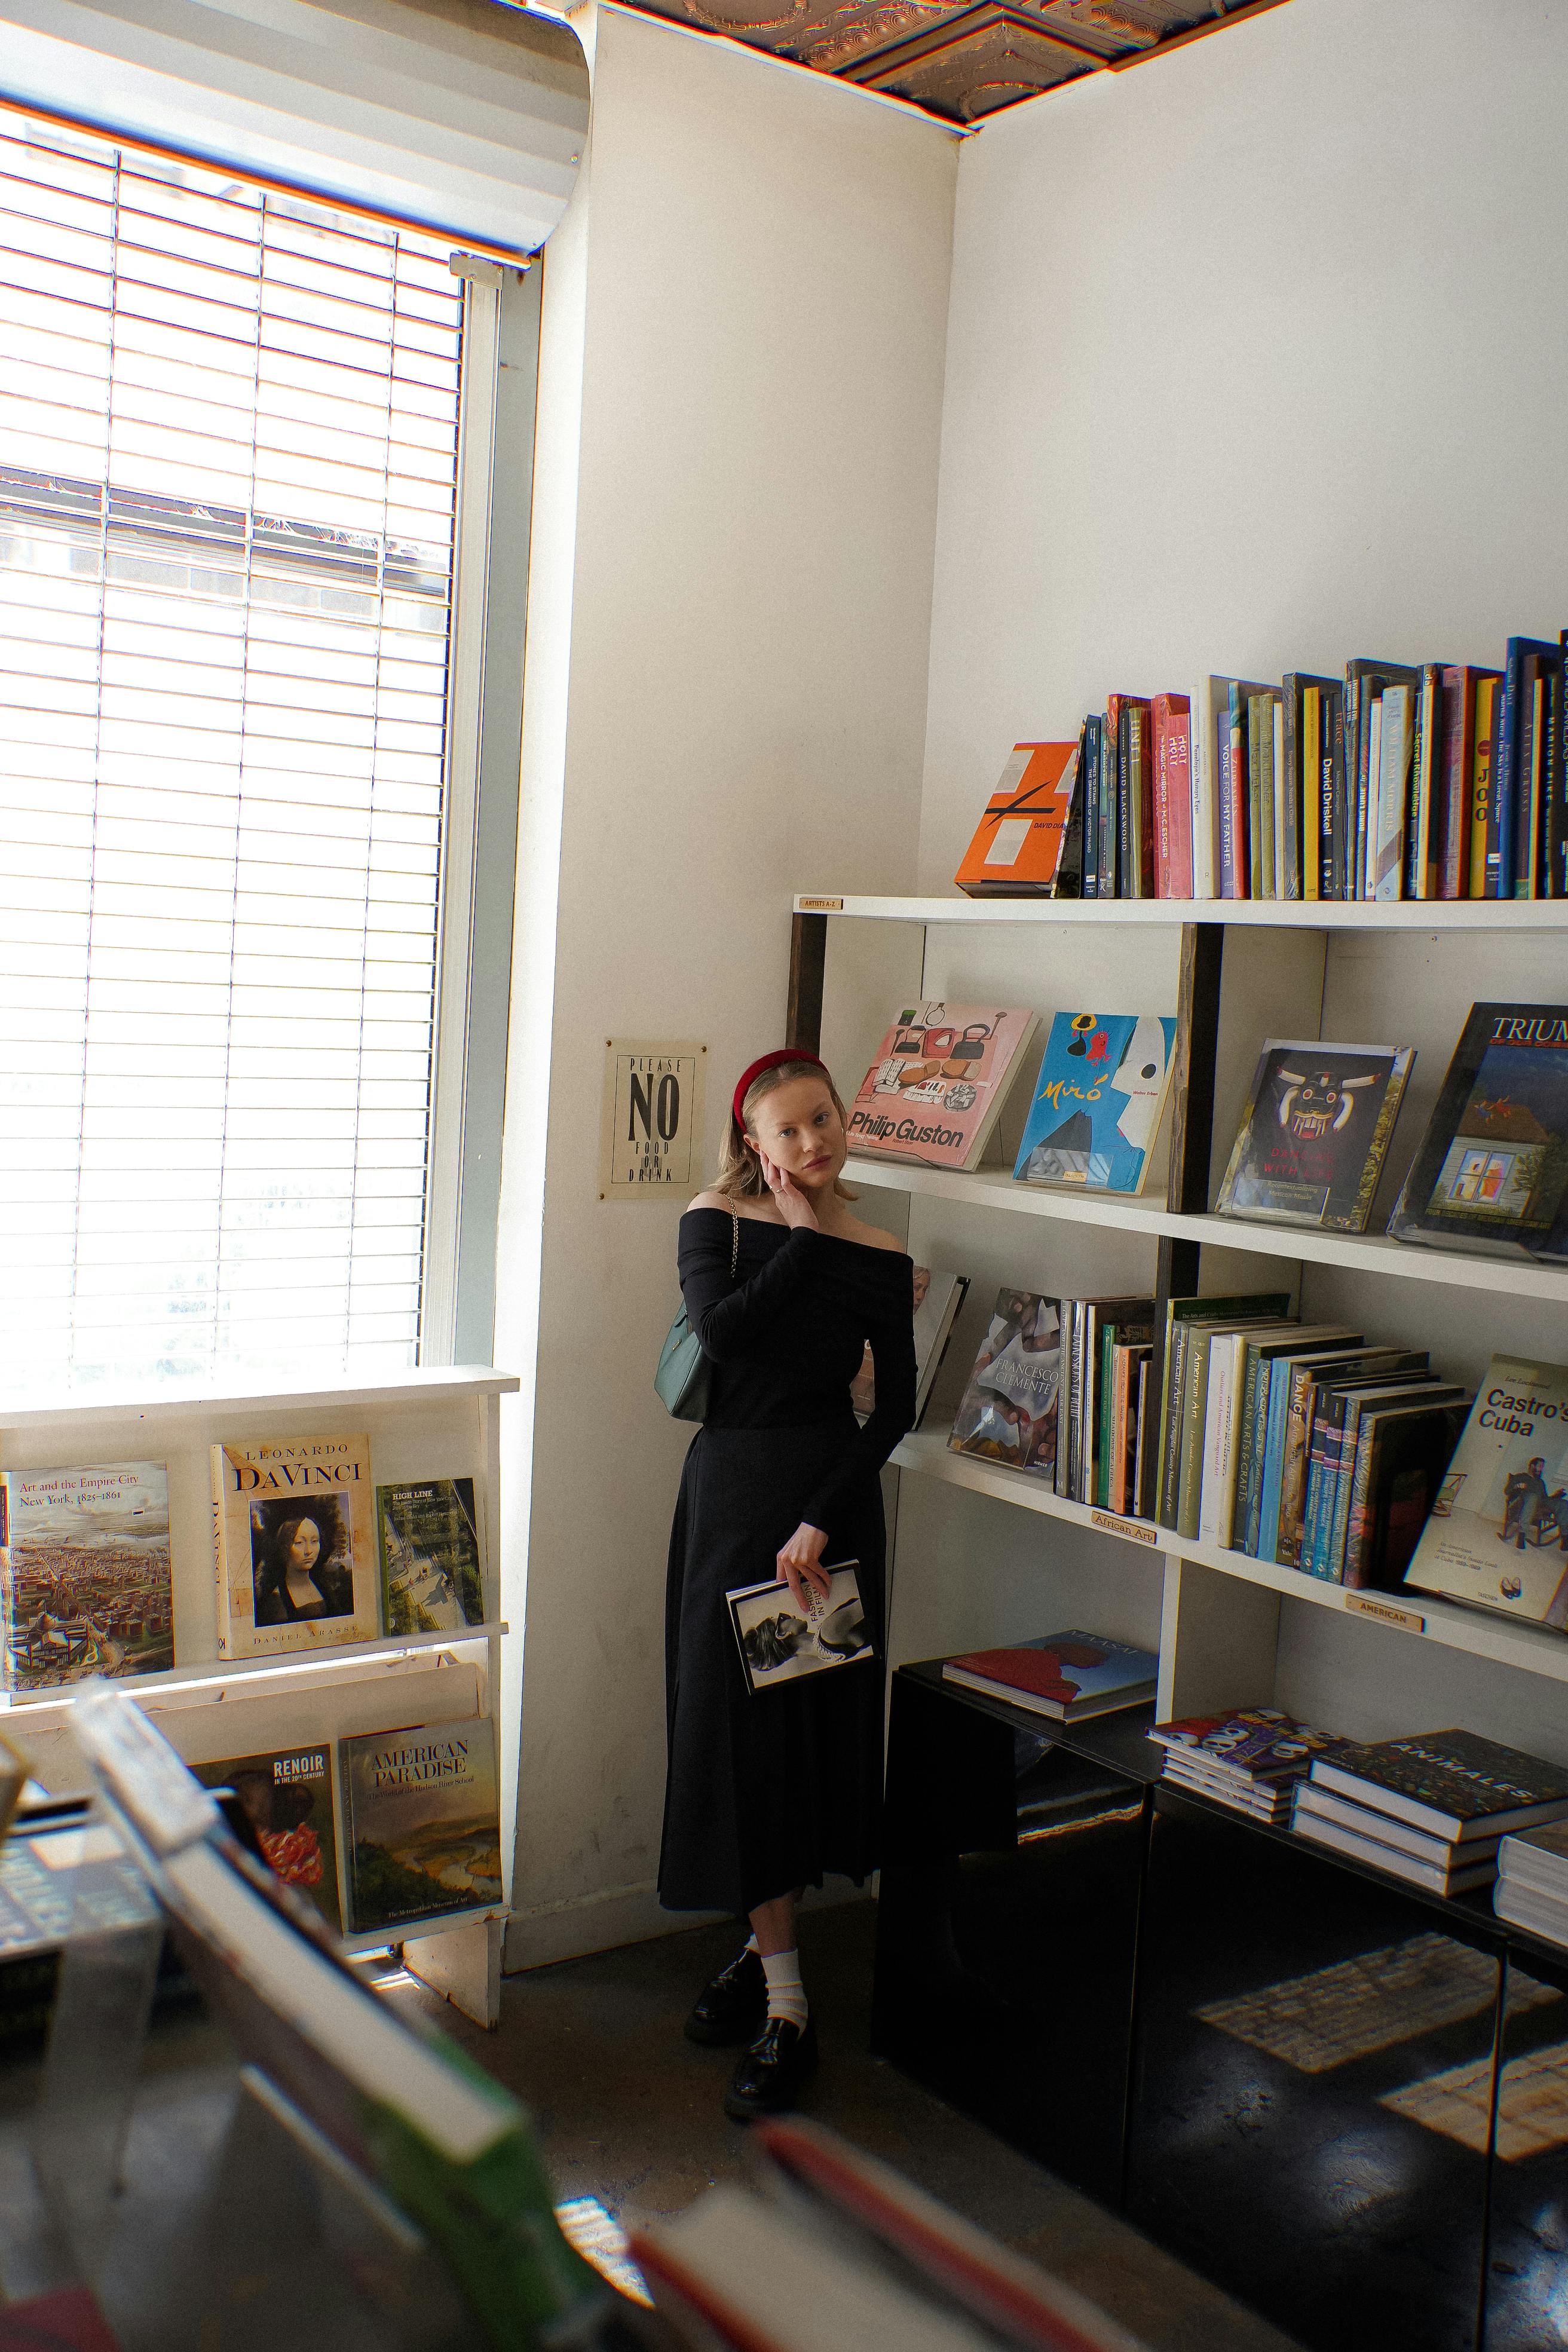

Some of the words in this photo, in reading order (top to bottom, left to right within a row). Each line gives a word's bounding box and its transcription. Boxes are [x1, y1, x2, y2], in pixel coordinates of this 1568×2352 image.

[1169, 736, 1178, 766] HOLY
[1178, 734, 1187, 764] HOLY
[1387, 725, 1398, 779] WILLIAM
[1413, 733, 1422, 764] Secret
[1322, 758, 1333, 792] David
[1411, 765, 1420, 816] Knowledge
[1521, 767, 1530, 813] GROSS
[1223, 803, 1231, 820] MY
[1322, 792, 1333, 835] Driskell
[1386, 783, 1395, 831] MORRIS
[630, 1058, 681, 1072] PLEASE
[1037, 1073, 1109, 1110] Miró
[628, 1073, 680, 1141] NO
[847, 1111, 897, 1141] Philip
[896, 1118, 964, 1148] Guston
[635, 1141, 669, 1154] FOOD
[644, 1154, 659, 1168] OR
[1263, 1163, 1298, 1175] WITH
[629, 1168, 672, 1182] DRINK
[1267, 1181, 1318, 1193] Recontextualizing
[1269, 1190, 1292, 1199] Mexican
[996, 1358, 1059, 1383] FRANCESCO
[1174, 1338, 1186, 1384] American
[996, 1371, 1051, 1395] CLEMENTE
[1192, 1351, 1203, 1397] American
[1517, 1377, 1550, 1390] Lockwood
[1173, 1387, 1183, 1405] Art
[1245, 1358, 1256, 1419] AMERICAN
[1292, 1374, 1304, 1422] DANCE
[1190, 1401, 1201, 1419] Art
[1257, 1397, 1266, 1430] CRAFTS
[1478, 1408, 1536, 1437] Cuba
[1243, 1422, 1252, 1451] ARTS
[1289, 1423, 1300, 1467] American
[246, 1443, 348, 1461] LEONARDO
[20, 1483, 36, 1493] Art
[39, 1480, 58, 1491] and
[60, 1479, 76, 1489] the
[79, 1477, 116, 1490] Empire
[118, 1473, 139, 1486] City
[1238, 1462, 1249, 1502] CRAFTS
[20, 1496, 45, 1508] New
[47, 1493, 74, 1505] York,
[393, 1492, 413, 1500] HIGH
[1095, 1515, 1132, 1534] African
[1436, 1548, 1466, 1560] Journalist's
[1447, 1543, 1472, 1554] American
[803, 1584, 819, 1622] FASHION
[1477, 1591, 1499, 1602] TASCHEN
[817, 1606, 825, 1616] IN
[1359, 1602, 1407, 1623] AMERICAN
[253, 1633, 302, 1646] DANIEL
[309, 1625, 359, 1638] ARASSE
[1070, 1630, 1138, 1655] MAASAI
[1288, 1734, 1330, 1750] DEAD
[274, 1754, 324, 1778] RENOIR
[370, 1739, 470, 1771] AMERICAN
[303, 1771, 325, 1780] CENTURY
[373, 1757, 467, 1788] PARADISE
[1388, 1741, 1534, 1800] ANIMALES
[367, 1792, 380, 1801] The
[380, 1790, 398, 1799] World
[415, 1783, 439, 1793] Hudson
[439, 1780, 455, 1788] River
[455, 1775, 474, 1786] School
[398, 1904, 432, 1916] Metropolitan
